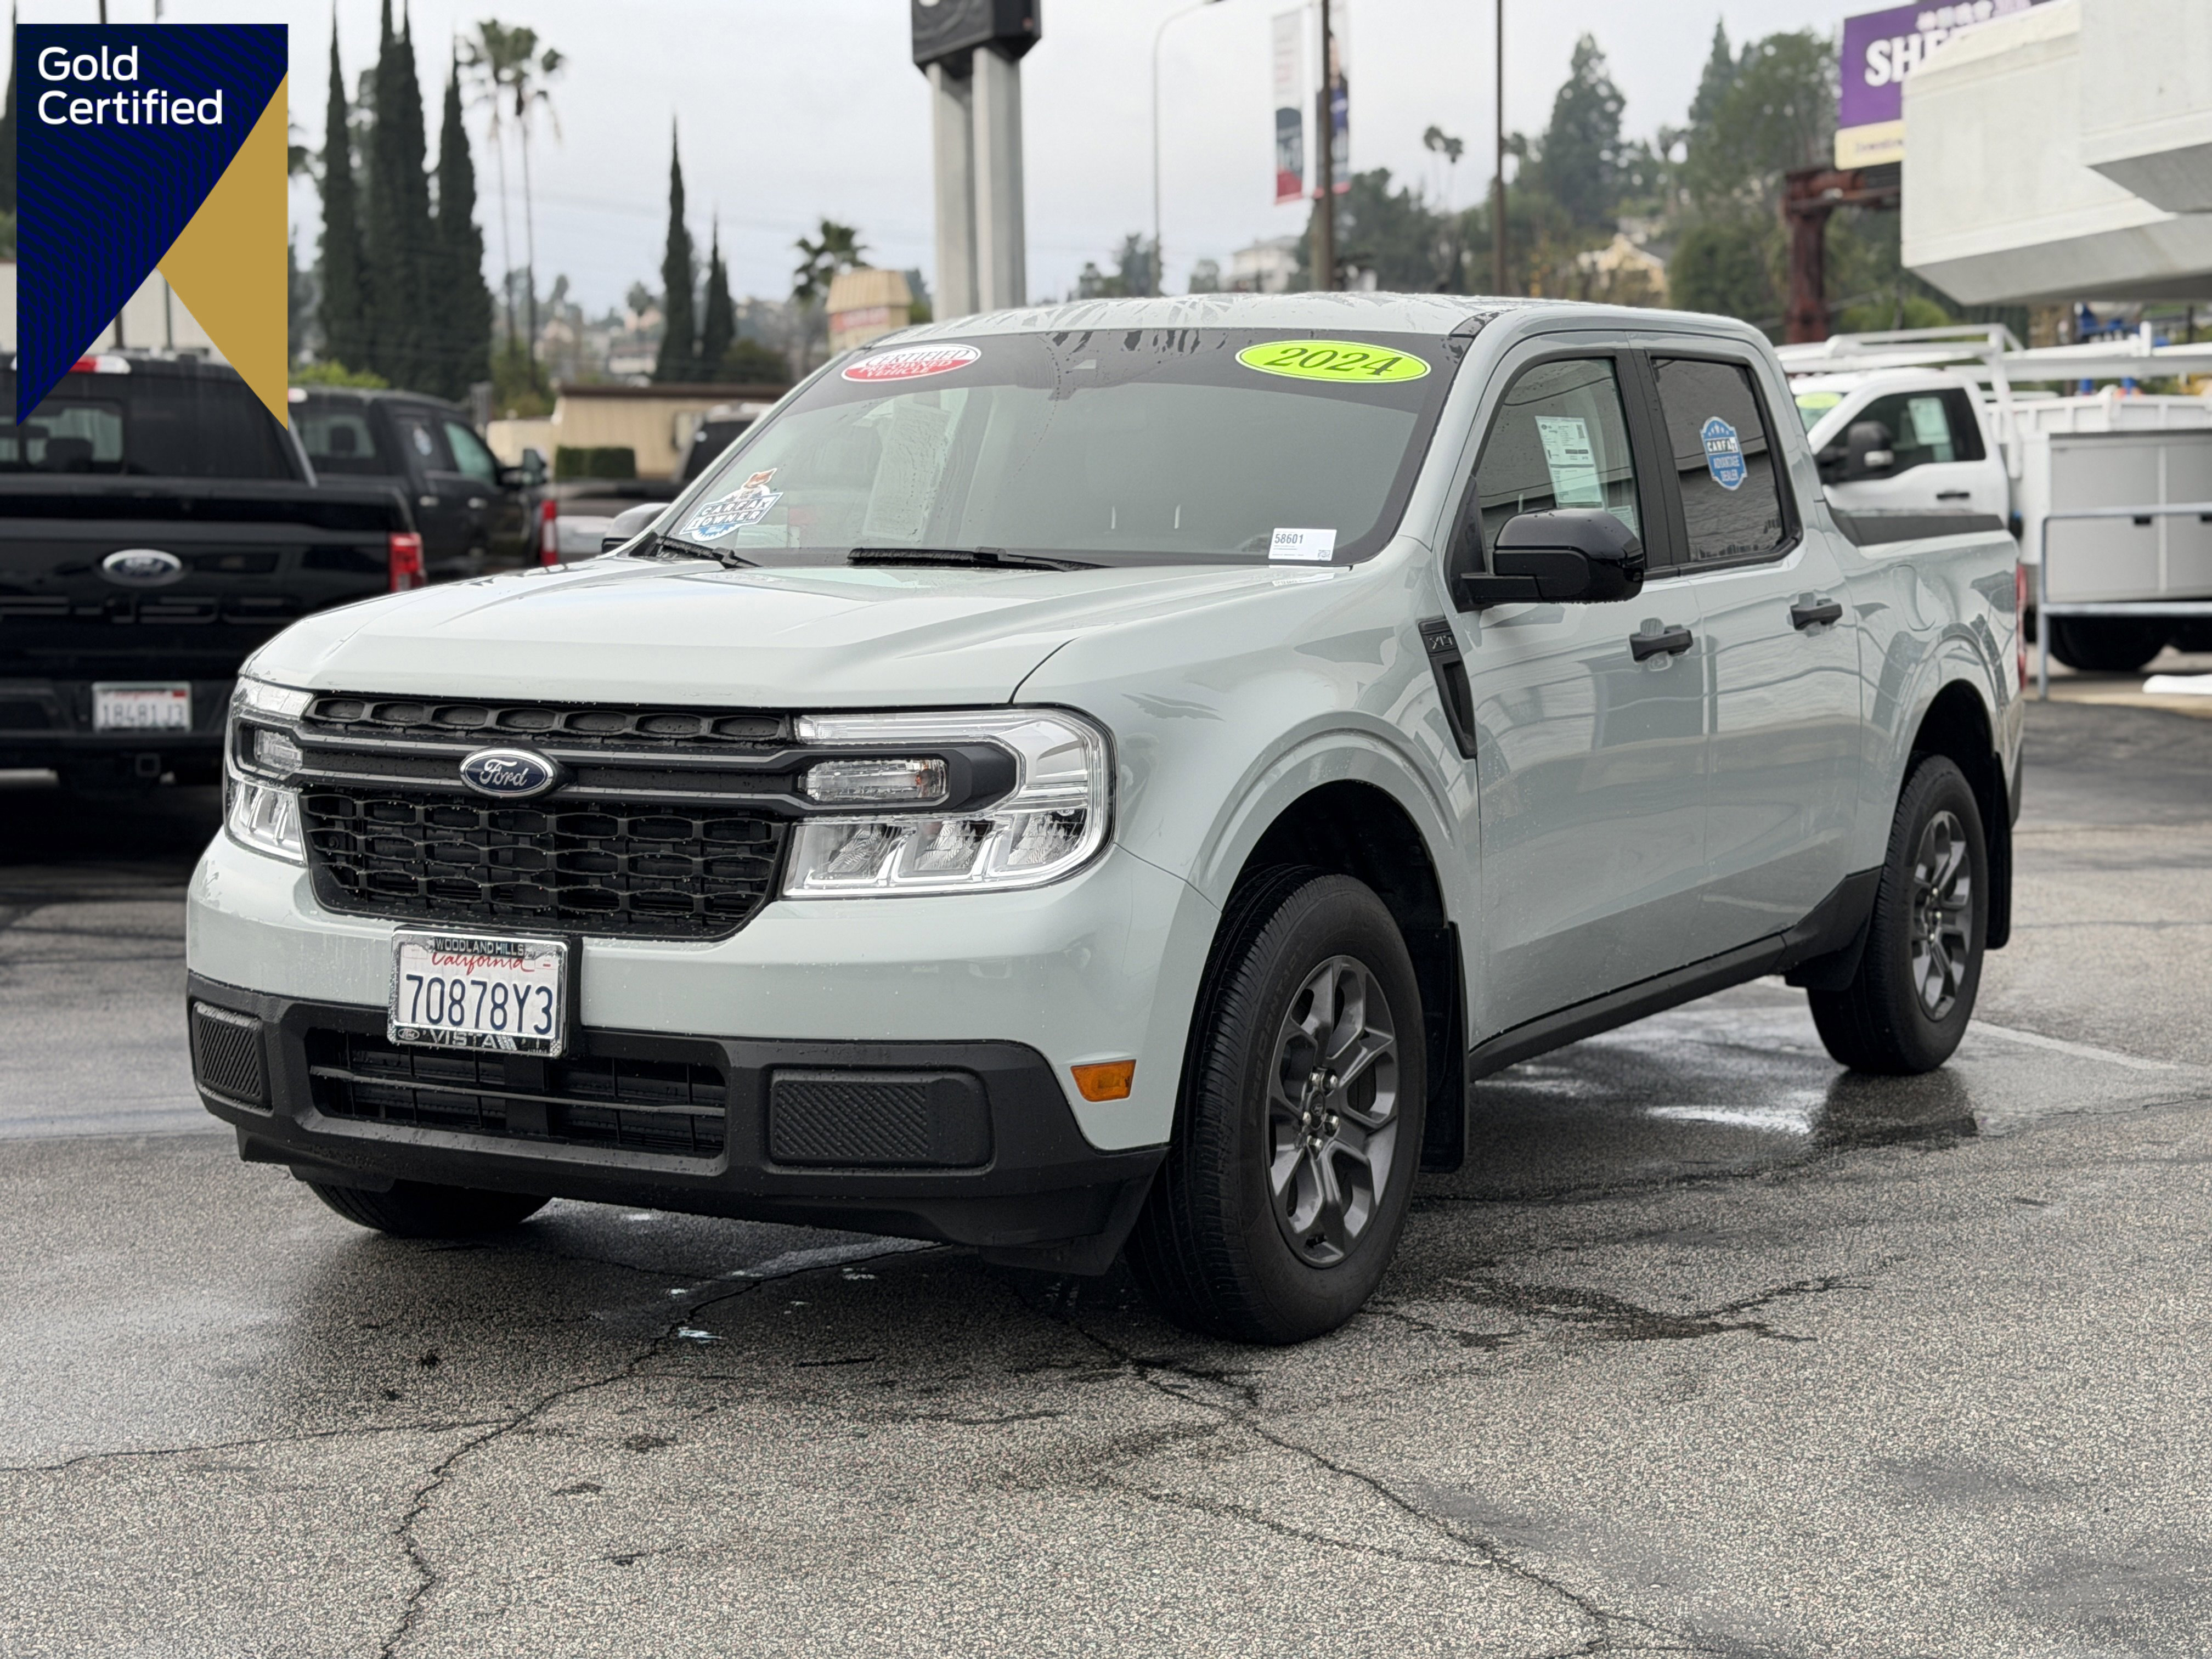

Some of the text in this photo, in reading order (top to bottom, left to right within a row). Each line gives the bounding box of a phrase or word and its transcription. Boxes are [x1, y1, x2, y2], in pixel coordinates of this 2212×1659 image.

[859, 360, 952, 373] PRE-OWNED
[866, 350, 970, 366] CERTIFIED
[1263, 348, 1403, 376] 2024
[867, 367, 930, 377] VEHICLE
[1707, 439, 1738, 453] CARFAX
[701, 499, 769, 516] CARFAX
[703, 511, 761, 526] OWNER
[1274, 533, 1304, 544] 58601
[479, 759, 529, 786] Ford
[435, 938, 524, 956] WOODLAND HILLS
[431, 952, 535, 975] California
[406, 973, 553, 1035] 70878Y3
[430, 1028, 498, 1049] VISTA
